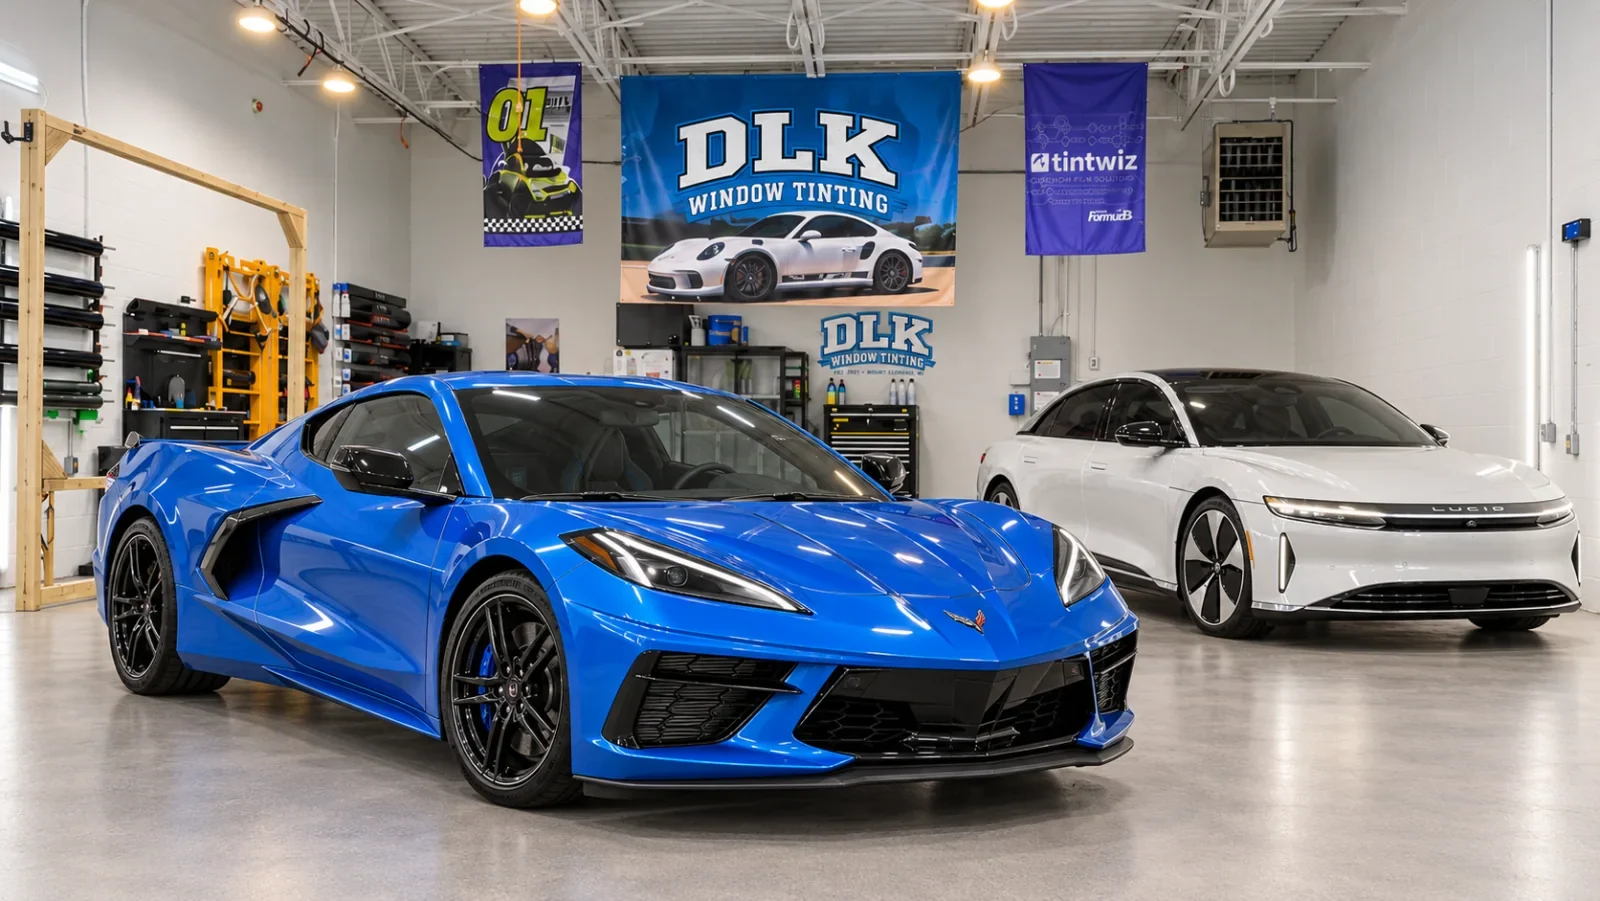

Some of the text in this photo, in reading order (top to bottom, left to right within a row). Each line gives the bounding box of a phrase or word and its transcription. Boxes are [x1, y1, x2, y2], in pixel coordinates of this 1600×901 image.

[486, 86, 548, 143] 01
[677, 110, 899, 191] DLK
[1052, 149, 1138, 172] tintwiz
[688, 181, 888, 216] WINDOW TINTING
[822, 312, 931, 358] DLK
[831, 352, 924, 368] WINDOW TINTING
